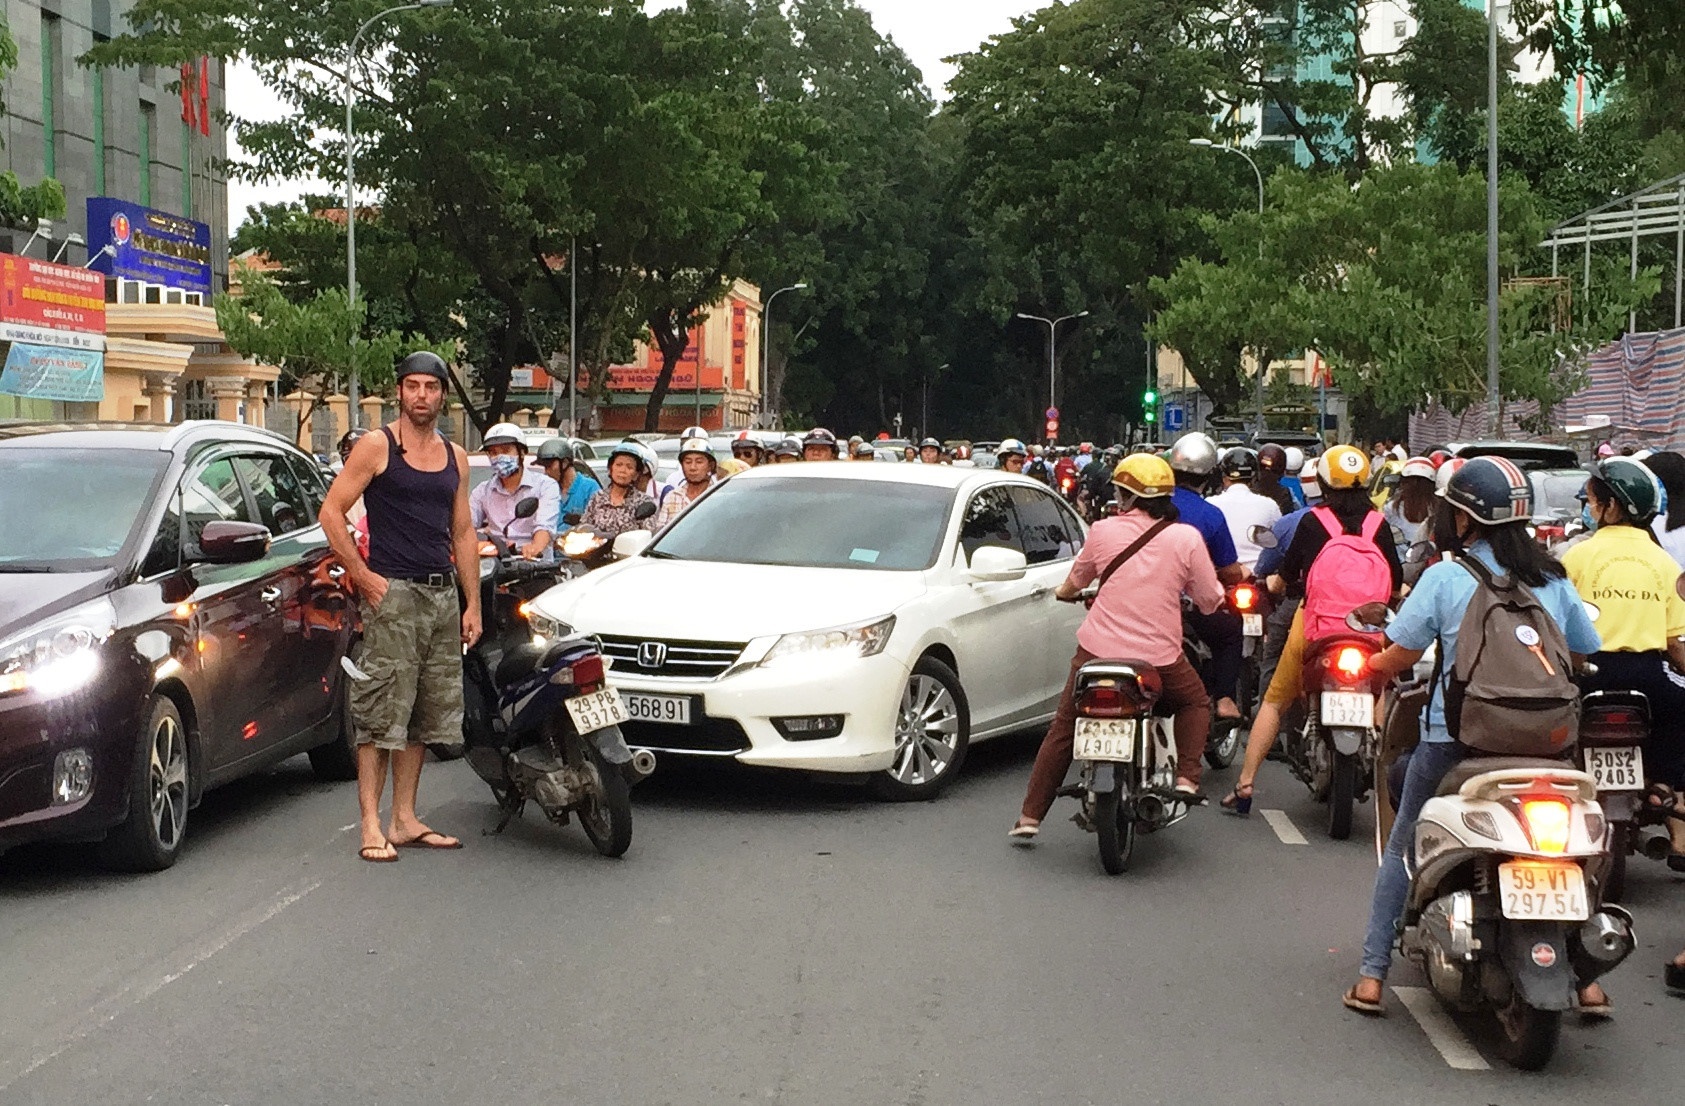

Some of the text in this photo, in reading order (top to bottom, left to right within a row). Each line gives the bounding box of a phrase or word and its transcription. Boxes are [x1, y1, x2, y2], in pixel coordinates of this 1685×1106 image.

[1347, 456, 1357, 467] 9
[1592, 585, 1661, 602] ĐỐNG ĐA
[573, 691, 616, 713] 29-P8
[581, 706, 621, 729] 9378
[1330, 709, 1366, 723] 1327
[1595, 751, 1633, 768] 50S2
[1594, 768, 1636, 785] 9403
[1512, 868, 1568, 891] 59-V1
[1508, 893, 1580, 915] 297.54
